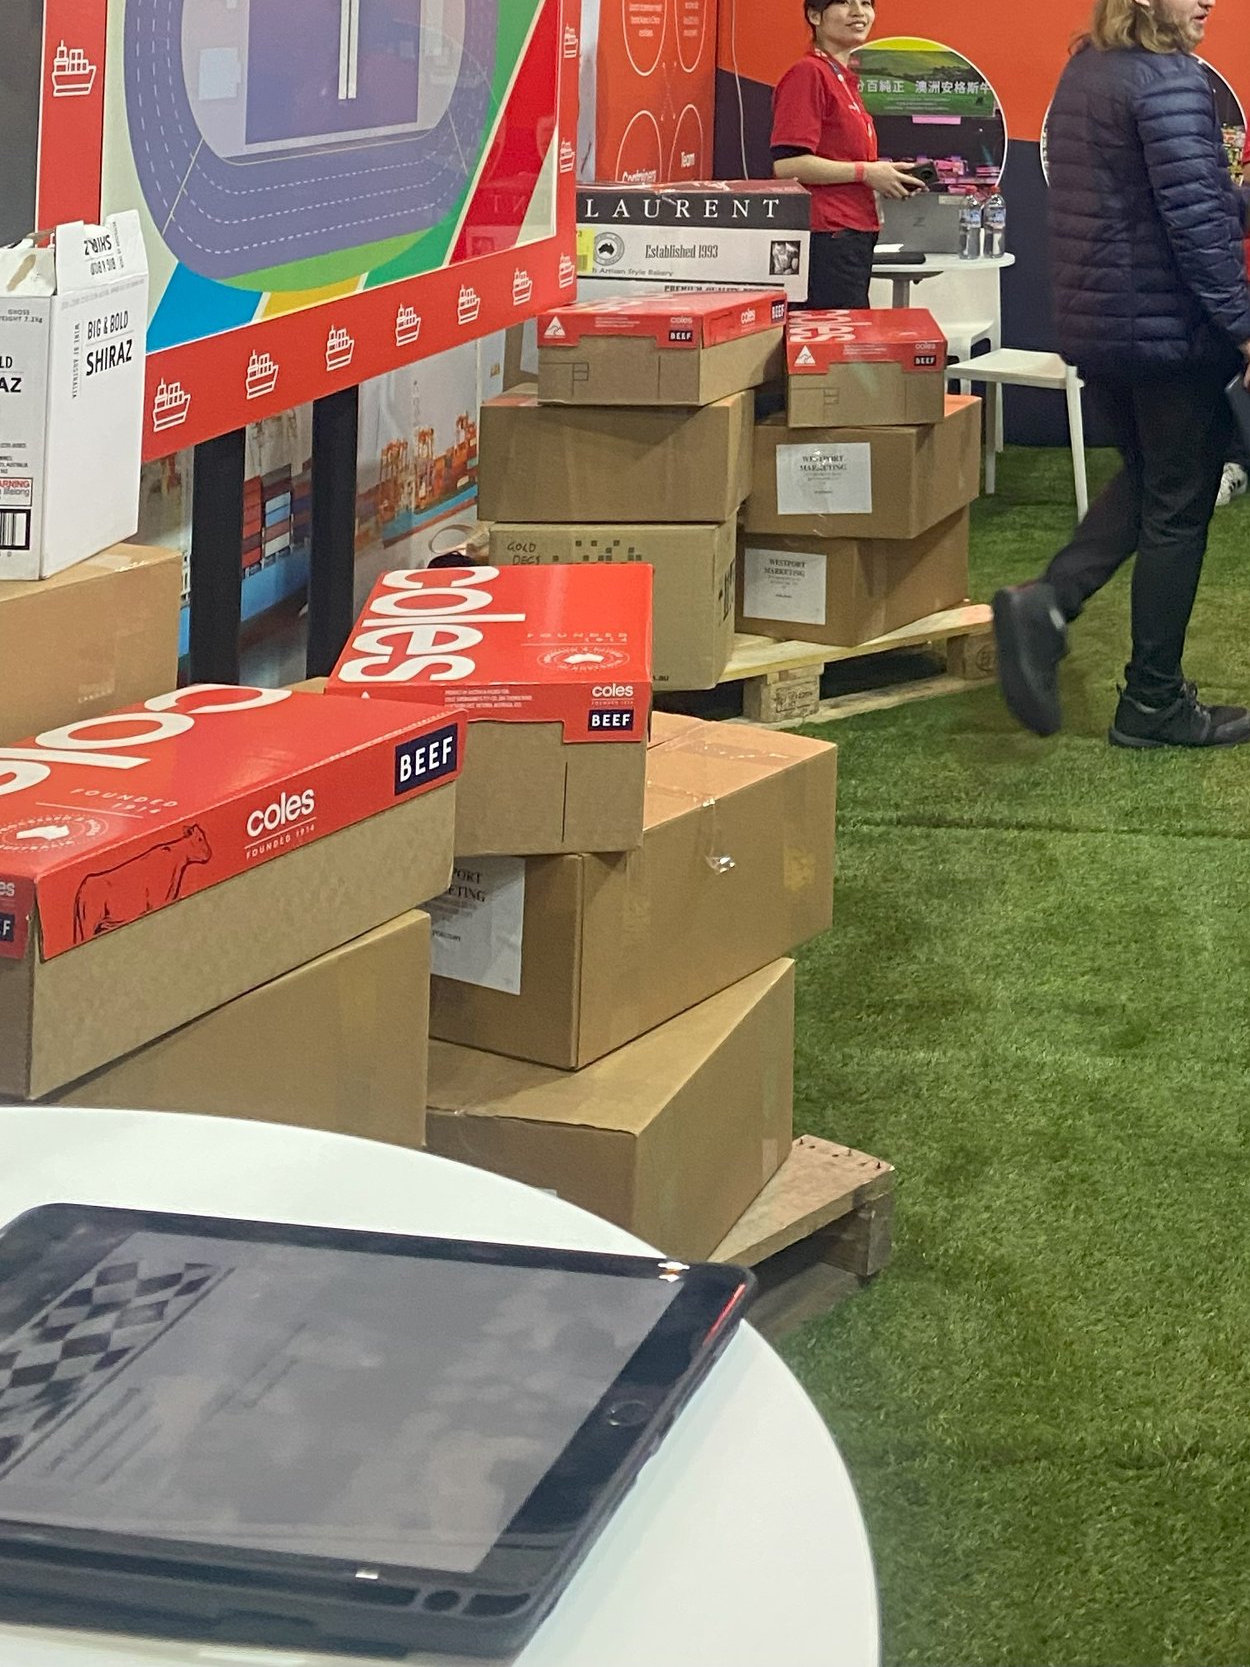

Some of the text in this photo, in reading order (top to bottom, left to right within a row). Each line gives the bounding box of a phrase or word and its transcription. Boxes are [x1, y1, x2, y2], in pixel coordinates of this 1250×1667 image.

[584, 198, 779, 218] LAURENT
[645, 244, 719, 259] Established 1993
[771, 303, 785, 319] BEEF
[87, 310, 129, 340] BIG & BOLD
[670, 332, 692, 340] BEEF
[86, 339, 133, 376] SHIRAZ
[915, 357, 936, 365] BEEF
[337, 566, 526, 683] coles
[592, 683, 634, 697] coles
[591, 714, 631, 727] BEEF
[399, 736, 453, 783] BEEF
[70, 788, 178, 808] FOUNDED
[246, 788, 315, 837] coles
[246, 834, 291, 860] FOUNDED
